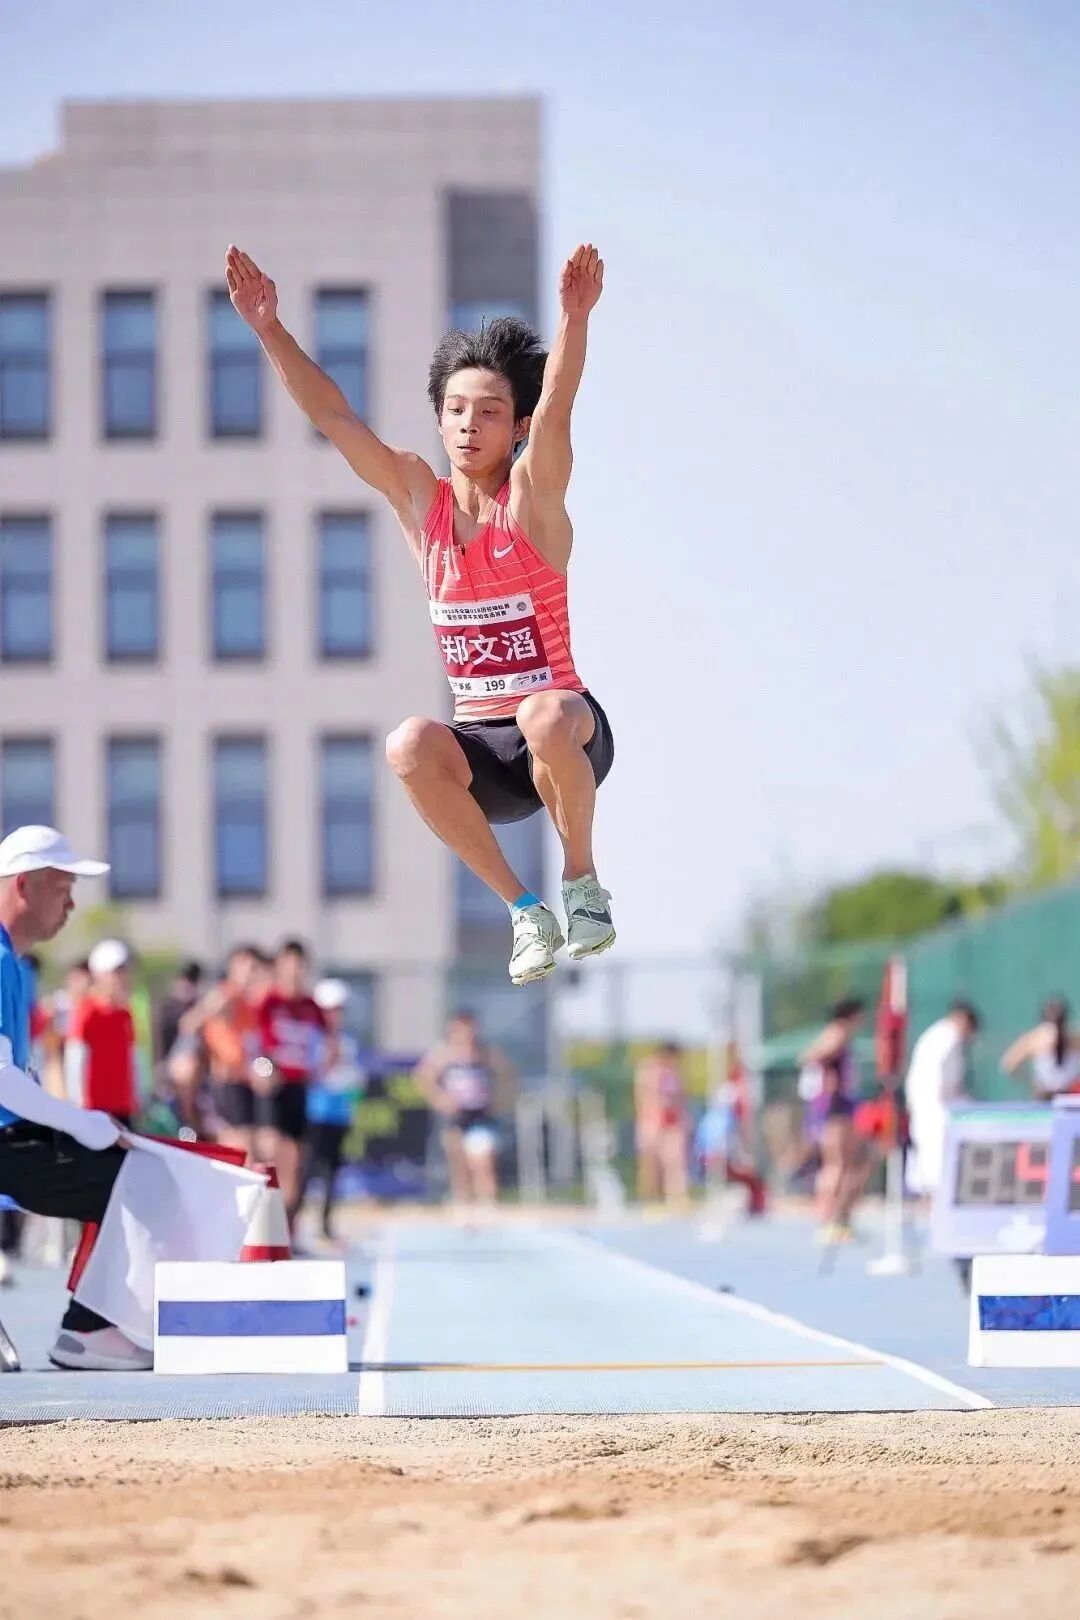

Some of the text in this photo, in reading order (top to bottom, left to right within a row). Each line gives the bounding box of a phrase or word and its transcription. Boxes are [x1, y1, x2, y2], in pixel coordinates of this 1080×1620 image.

[440, 626, 538, 666] 郑文滔
[485, 679, 506, 692] 199
